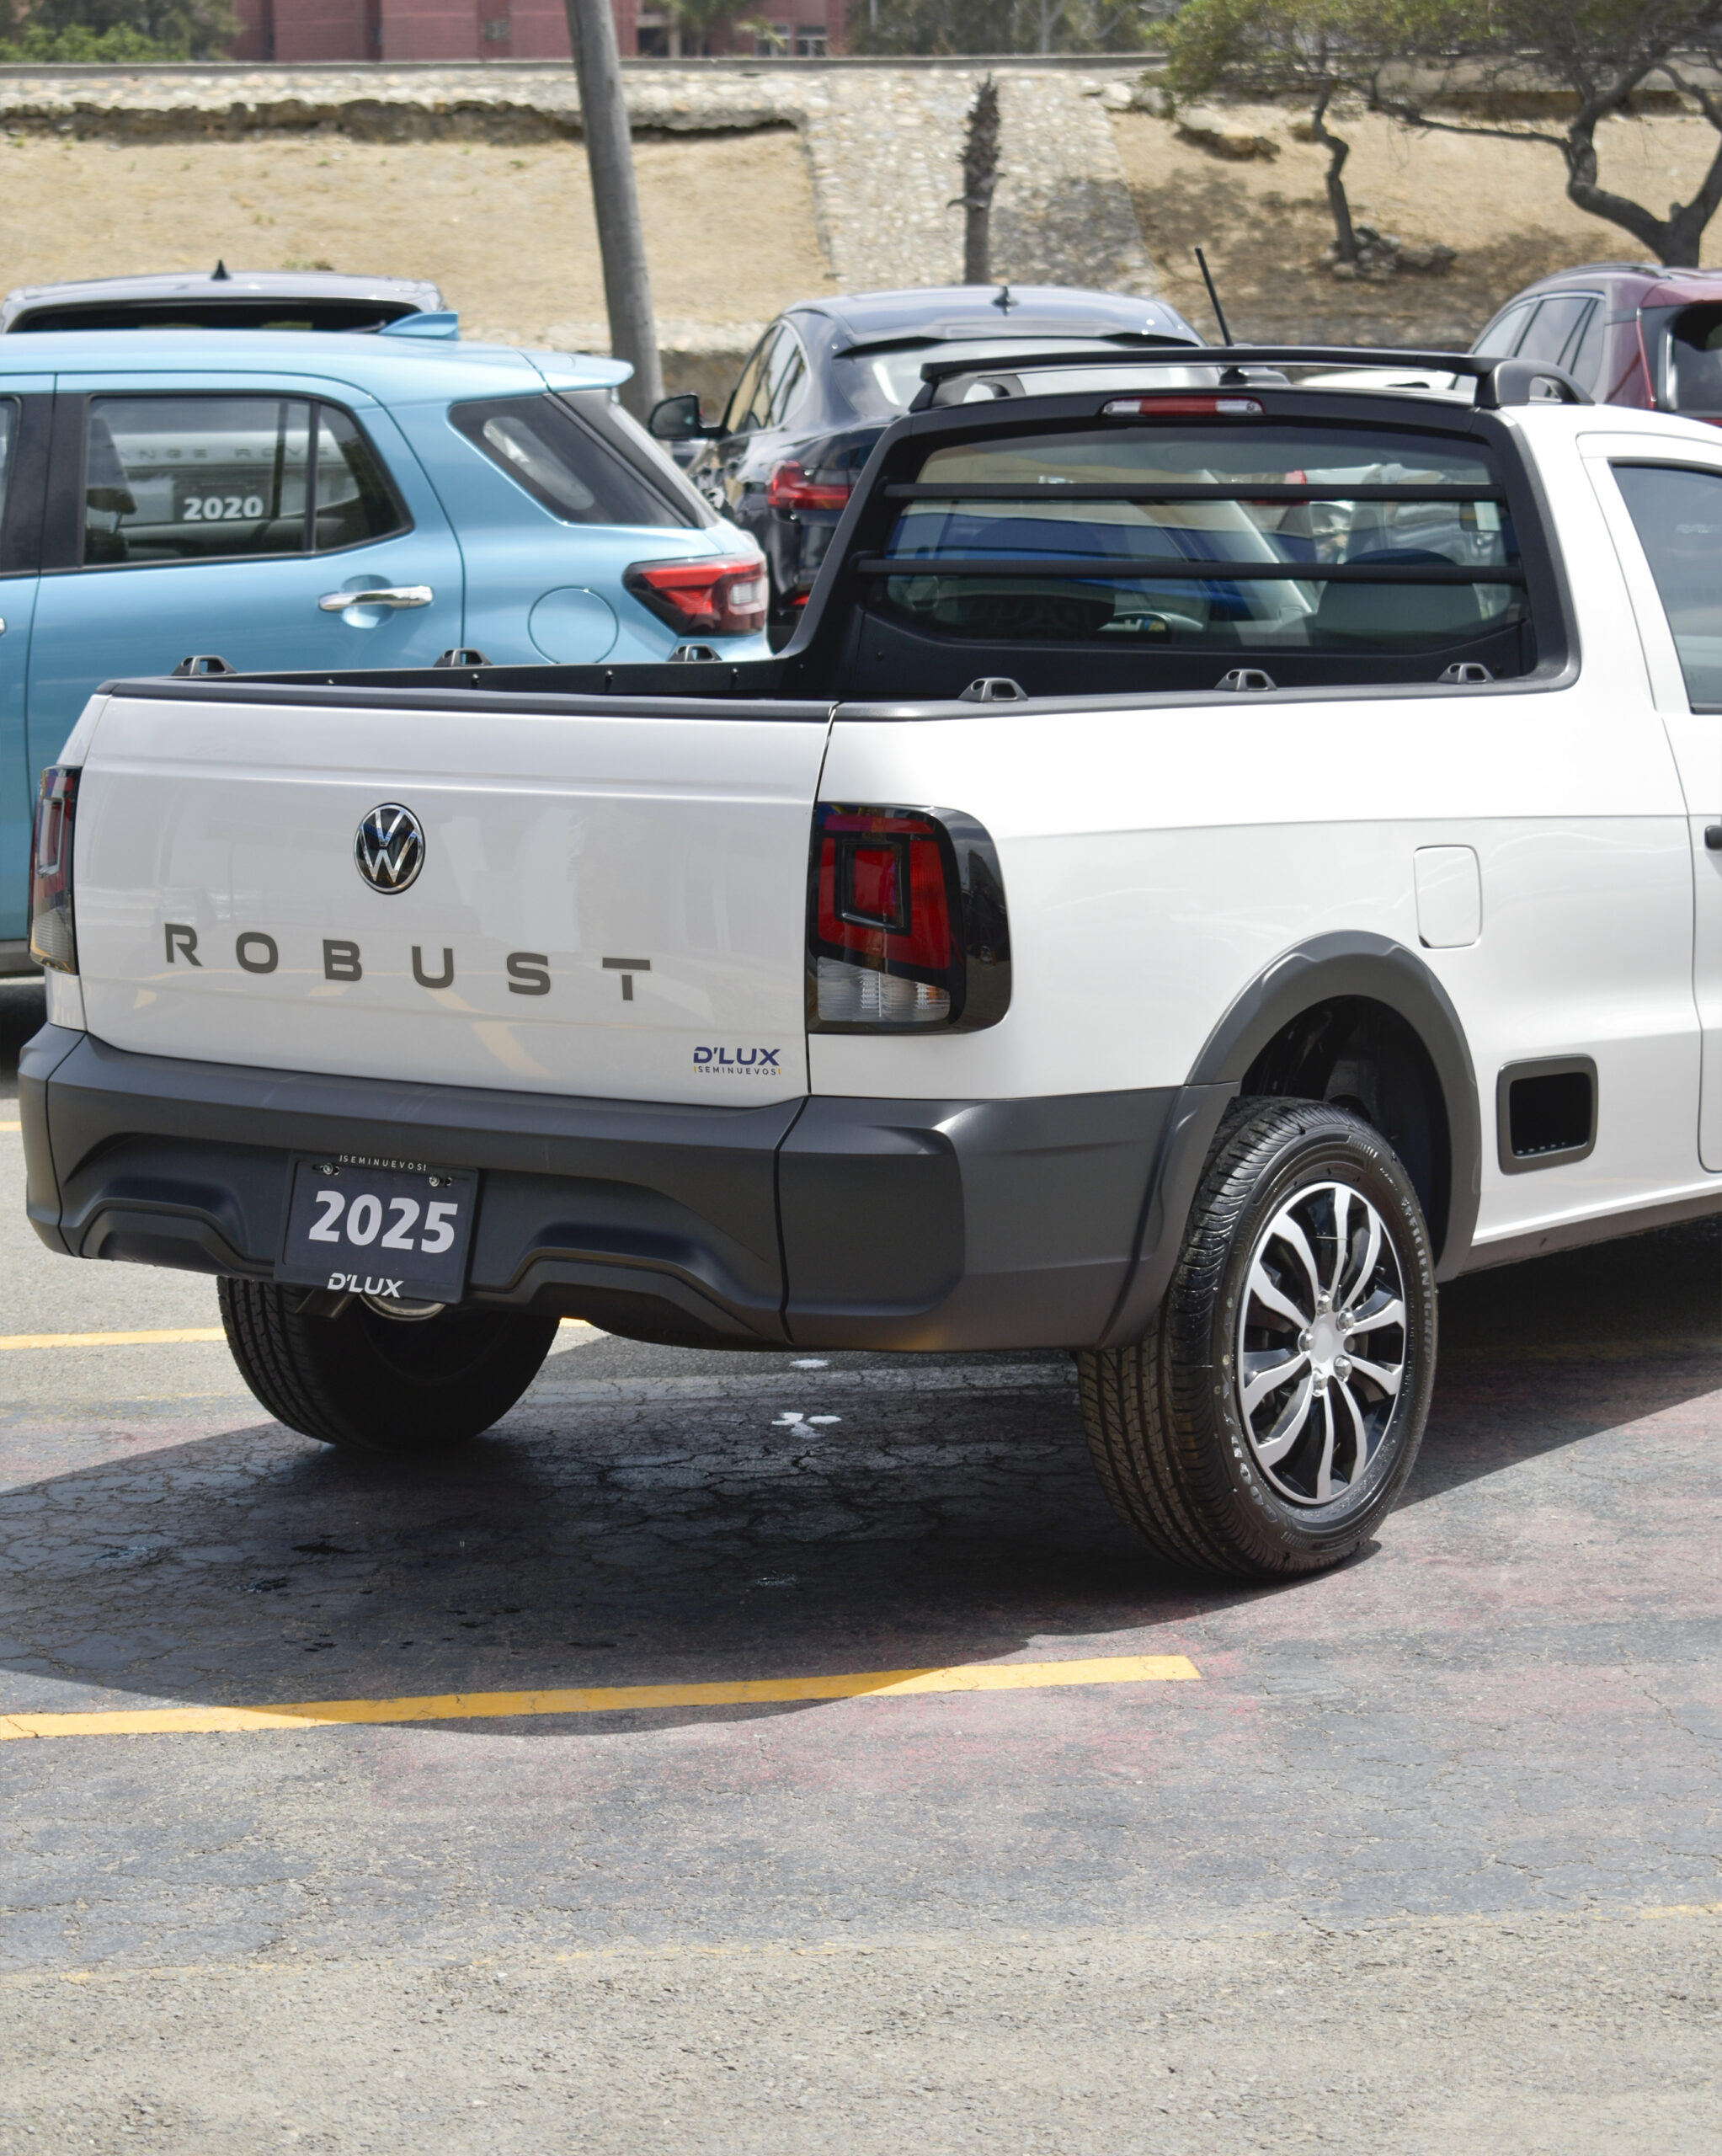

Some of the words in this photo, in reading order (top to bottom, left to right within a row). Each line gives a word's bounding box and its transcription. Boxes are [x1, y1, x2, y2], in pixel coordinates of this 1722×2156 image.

[183, 496, 264, 520] 2020
[358, 807, 419, 884] VW
[164, 923, 651, 1001] ROBUST
[693, 1046, 781, 1066] D'LUX
[308, 1190, 459, 1254] 2025
[327, 1273, 405, 1299] D'LUX
